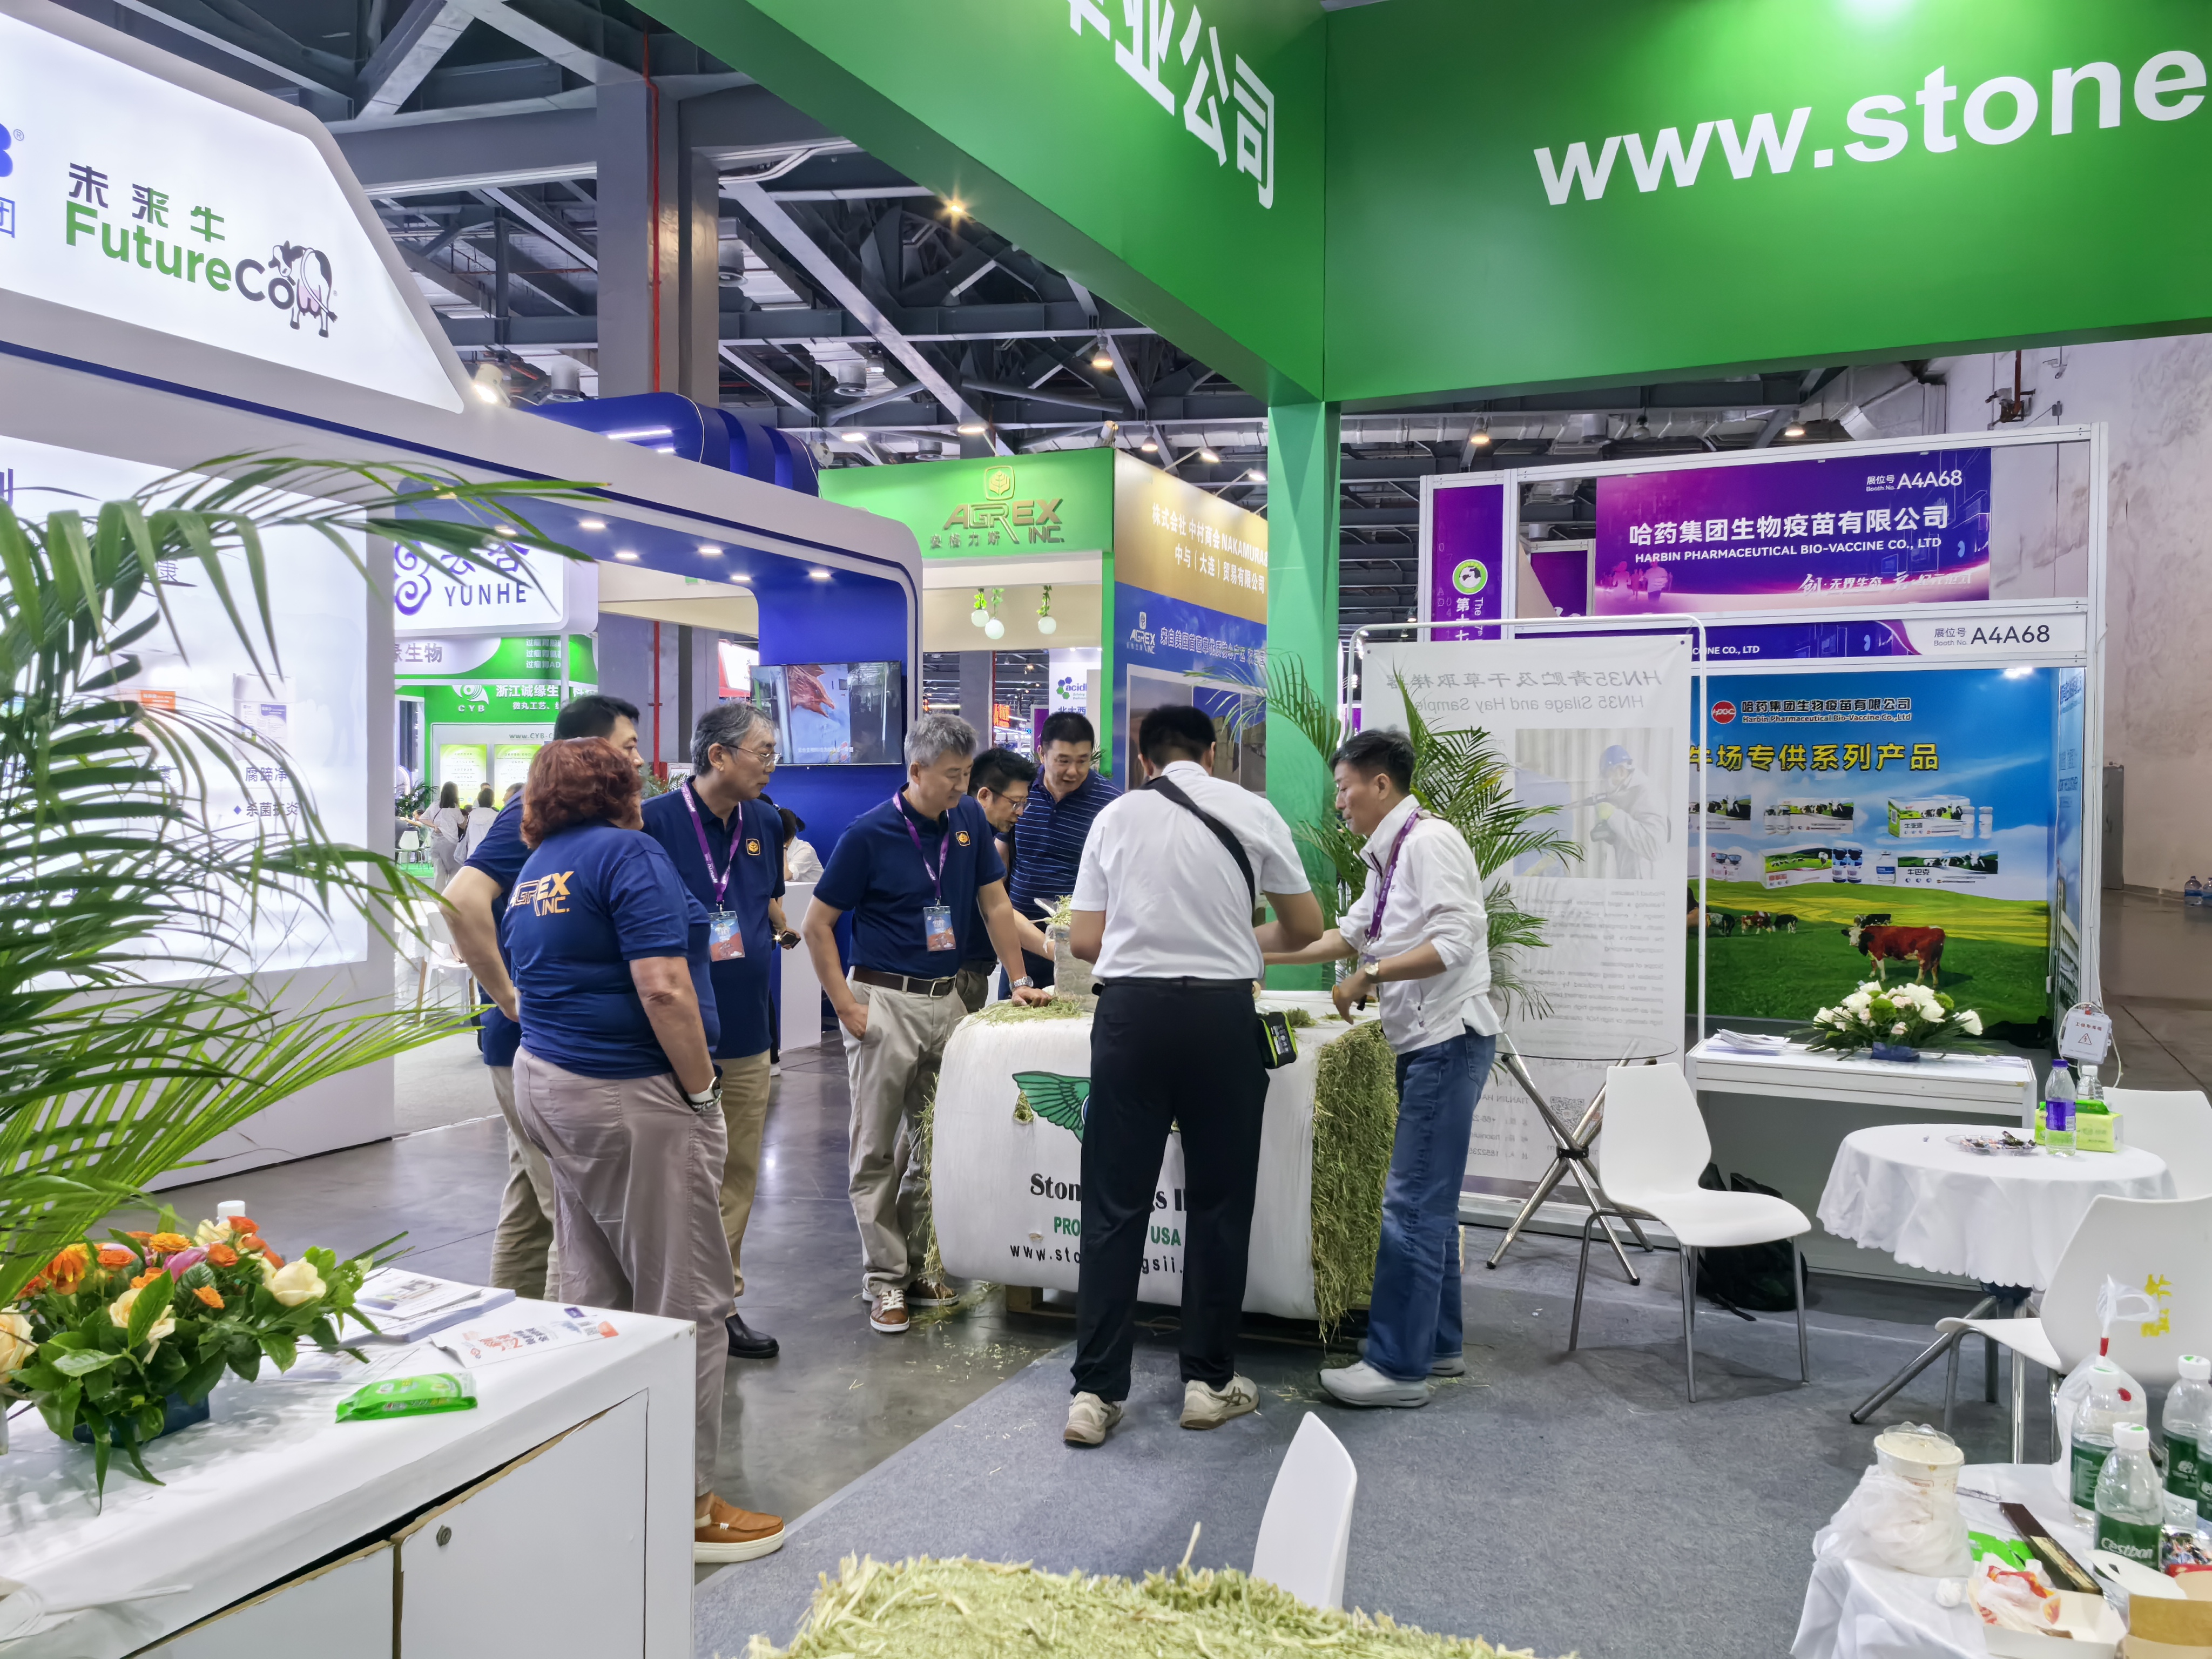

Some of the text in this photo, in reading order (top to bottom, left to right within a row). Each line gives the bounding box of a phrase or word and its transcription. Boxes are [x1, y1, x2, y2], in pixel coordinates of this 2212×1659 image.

[69, 162, 225, 242] 未来牛
[1866, 474, 1895, 485] 展位号
[1897, 469, 1963, 490] A4A68
[943, 498, 1064, 544] AGREX
[1151, 502, 1186, 536] 株式会社
[1629, 504, 1948, 547] 哈药集团生物疫苗有限公司
[1028, 525, 1065, 544] INC.
[1635, 537, 1942, 563] HARBIN PHARMACEUTICAL BIO-VACCINE CO., LTD
[444, 583, 527, 606] YUNHE
[1934, 628, 1966, 639] 展位号
[1971, 625, 2051, 645] A4A68
[1742, 645, 1760, 654] LTD
[1742, 697, 1912, 713] 哈药集团生物疫苗有限公司
[1770, 713, 1832, 723] Pharmaceutical
[541, 896, 571, 916] INC.
[1150, 1225, 1182, 1246] USA
